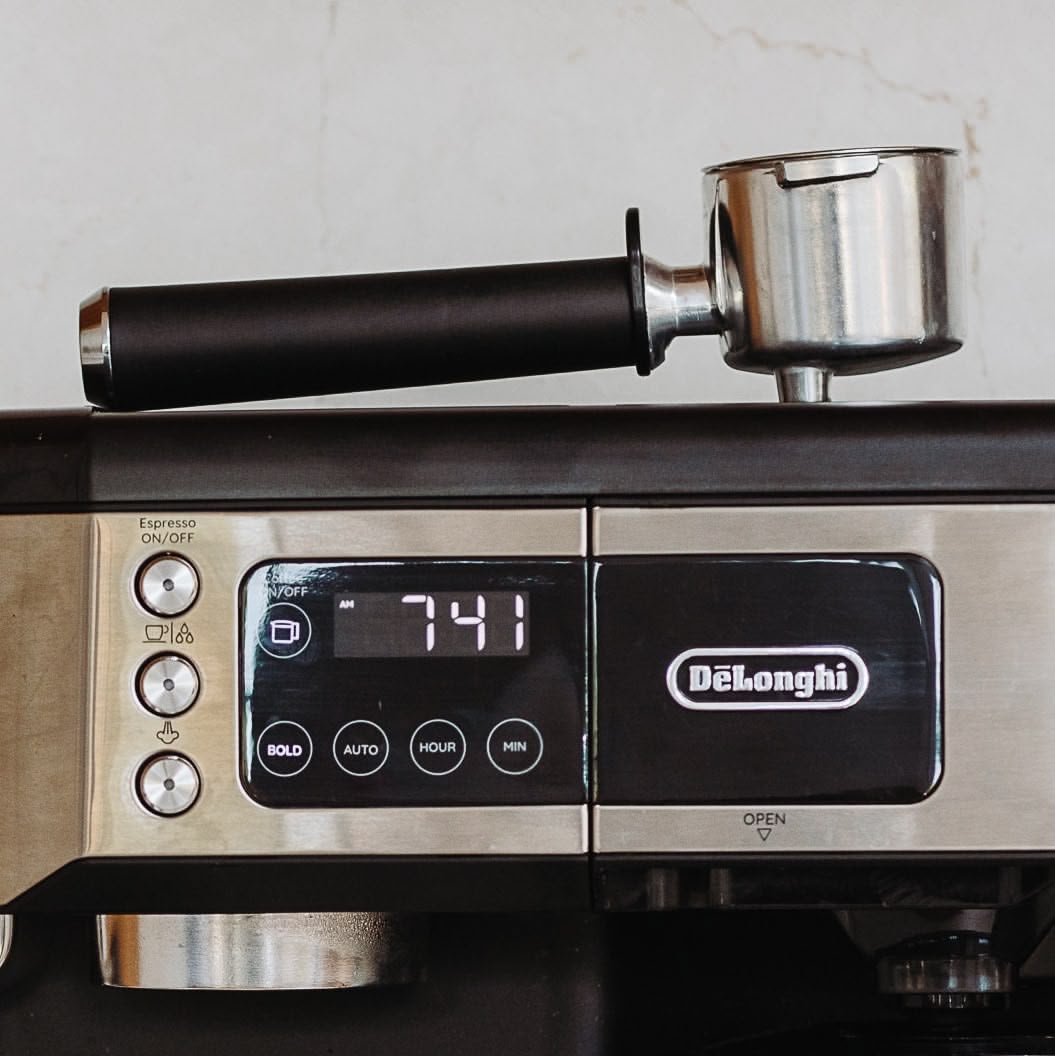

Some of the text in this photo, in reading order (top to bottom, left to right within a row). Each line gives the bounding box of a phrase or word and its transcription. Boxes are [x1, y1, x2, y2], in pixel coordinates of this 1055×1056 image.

[139, 517, 196, 531] Espresso
[141, 531, 194, 545] ON/OFF
[266, 585, 308, 599] N/OFF
[339, 599, 355, 609] AM
[402, 594, 524, 652] 741
[267, 744, 302, 757] BOLD
[343, 744, 379, 757] AUTO
[419, 741, 457, 754] HOUR
[503, 741, 527, 753] MIN
[743, 812, 786, 826] OPEN
